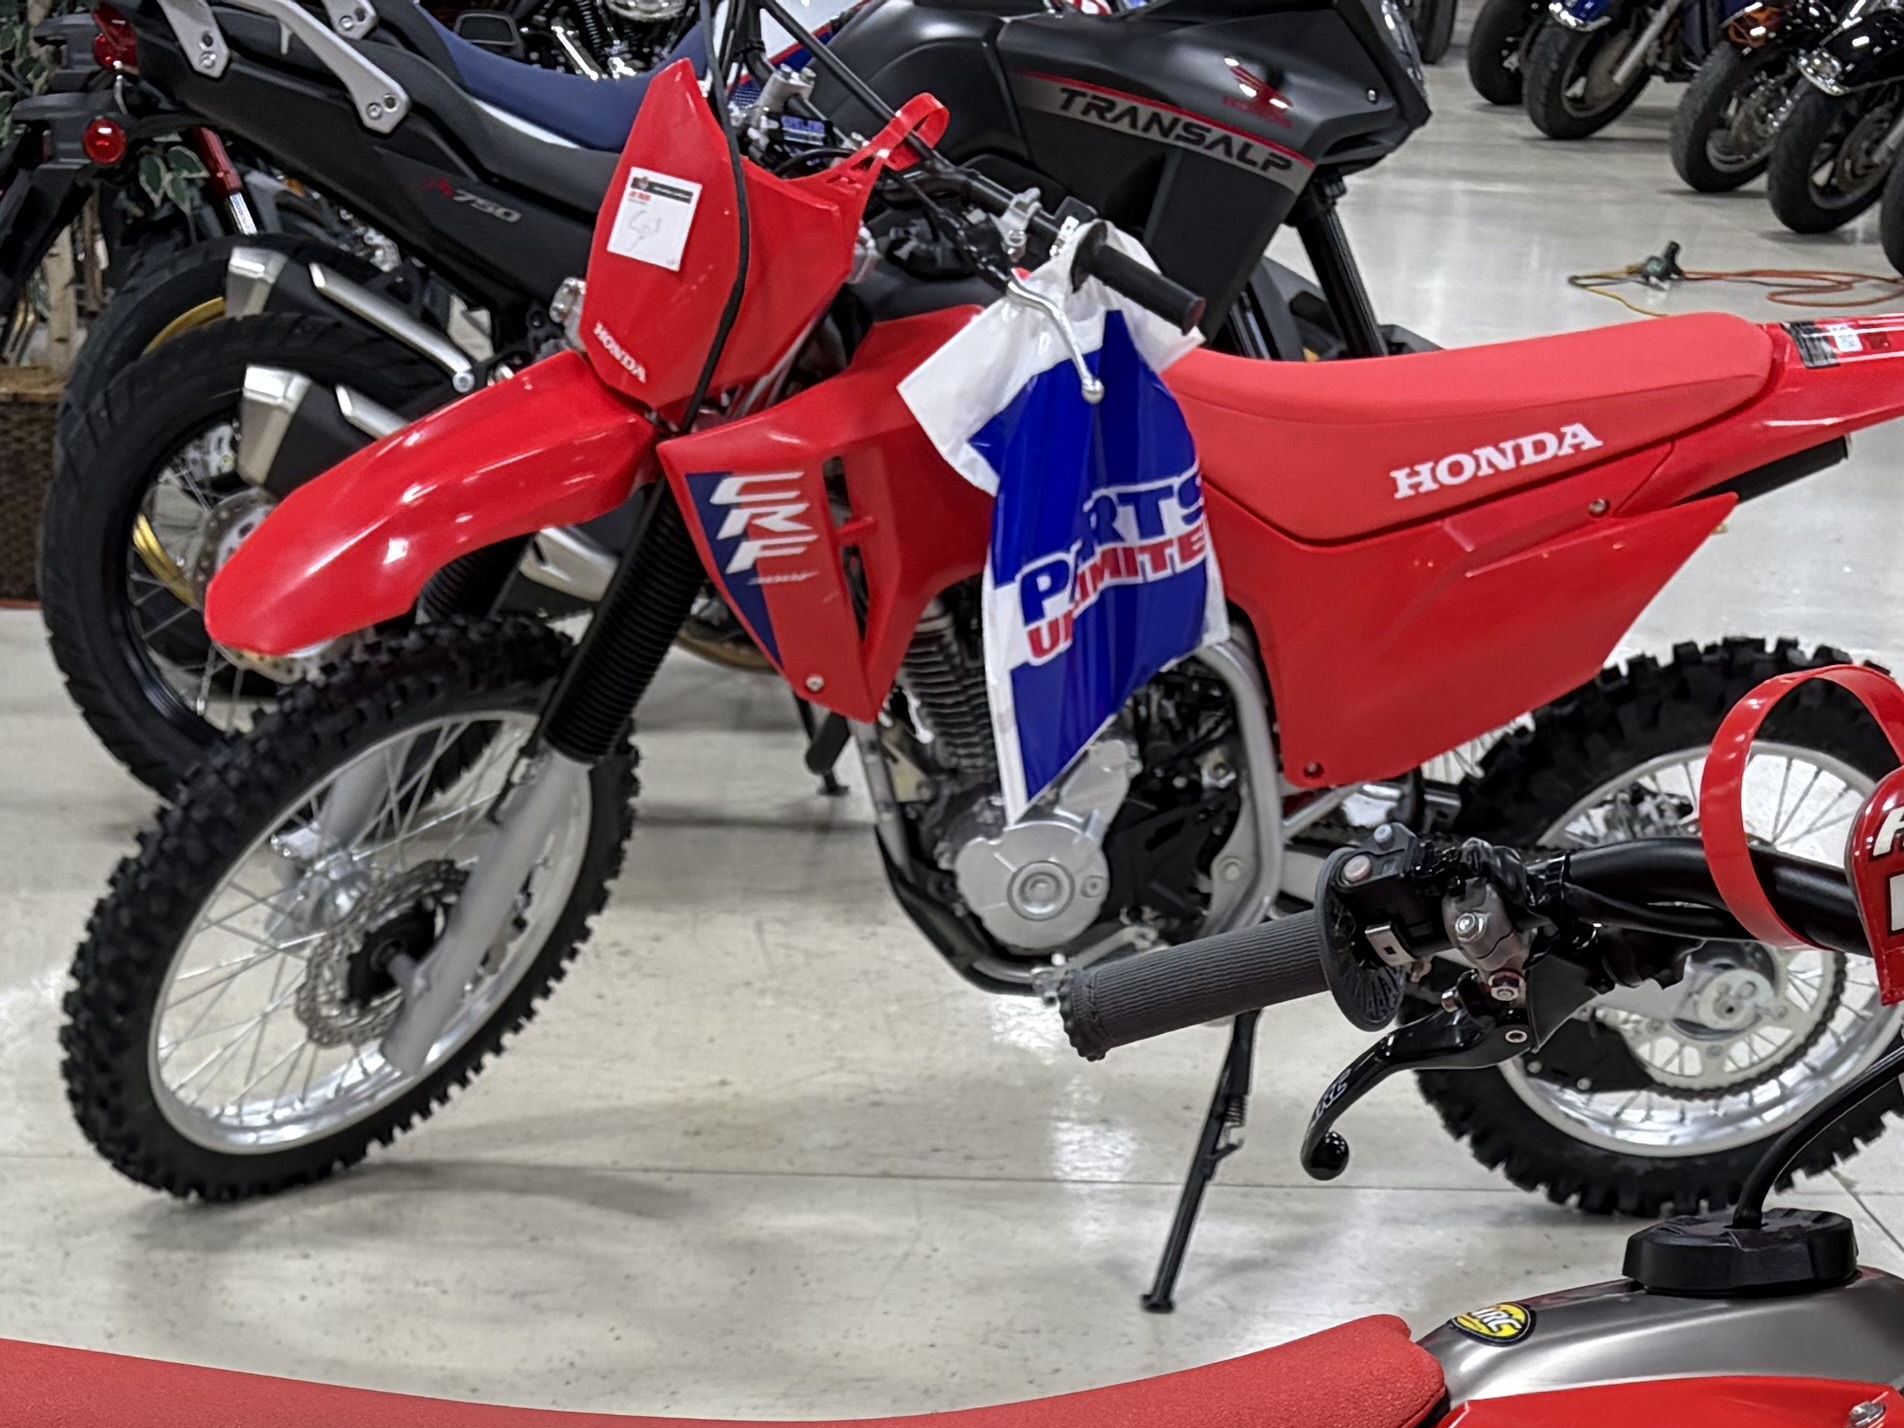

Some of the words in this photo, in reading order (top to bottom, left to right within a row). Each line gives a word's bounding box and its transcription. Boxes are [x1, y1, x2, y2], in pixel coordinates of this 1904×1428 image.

[1059, 87, 1293, 173] TRANSALP
[594, 320, 646, 383] HONDA
[1391, 422, 1603, 501] HONDA
[709, 471, 818, 575] CRF
